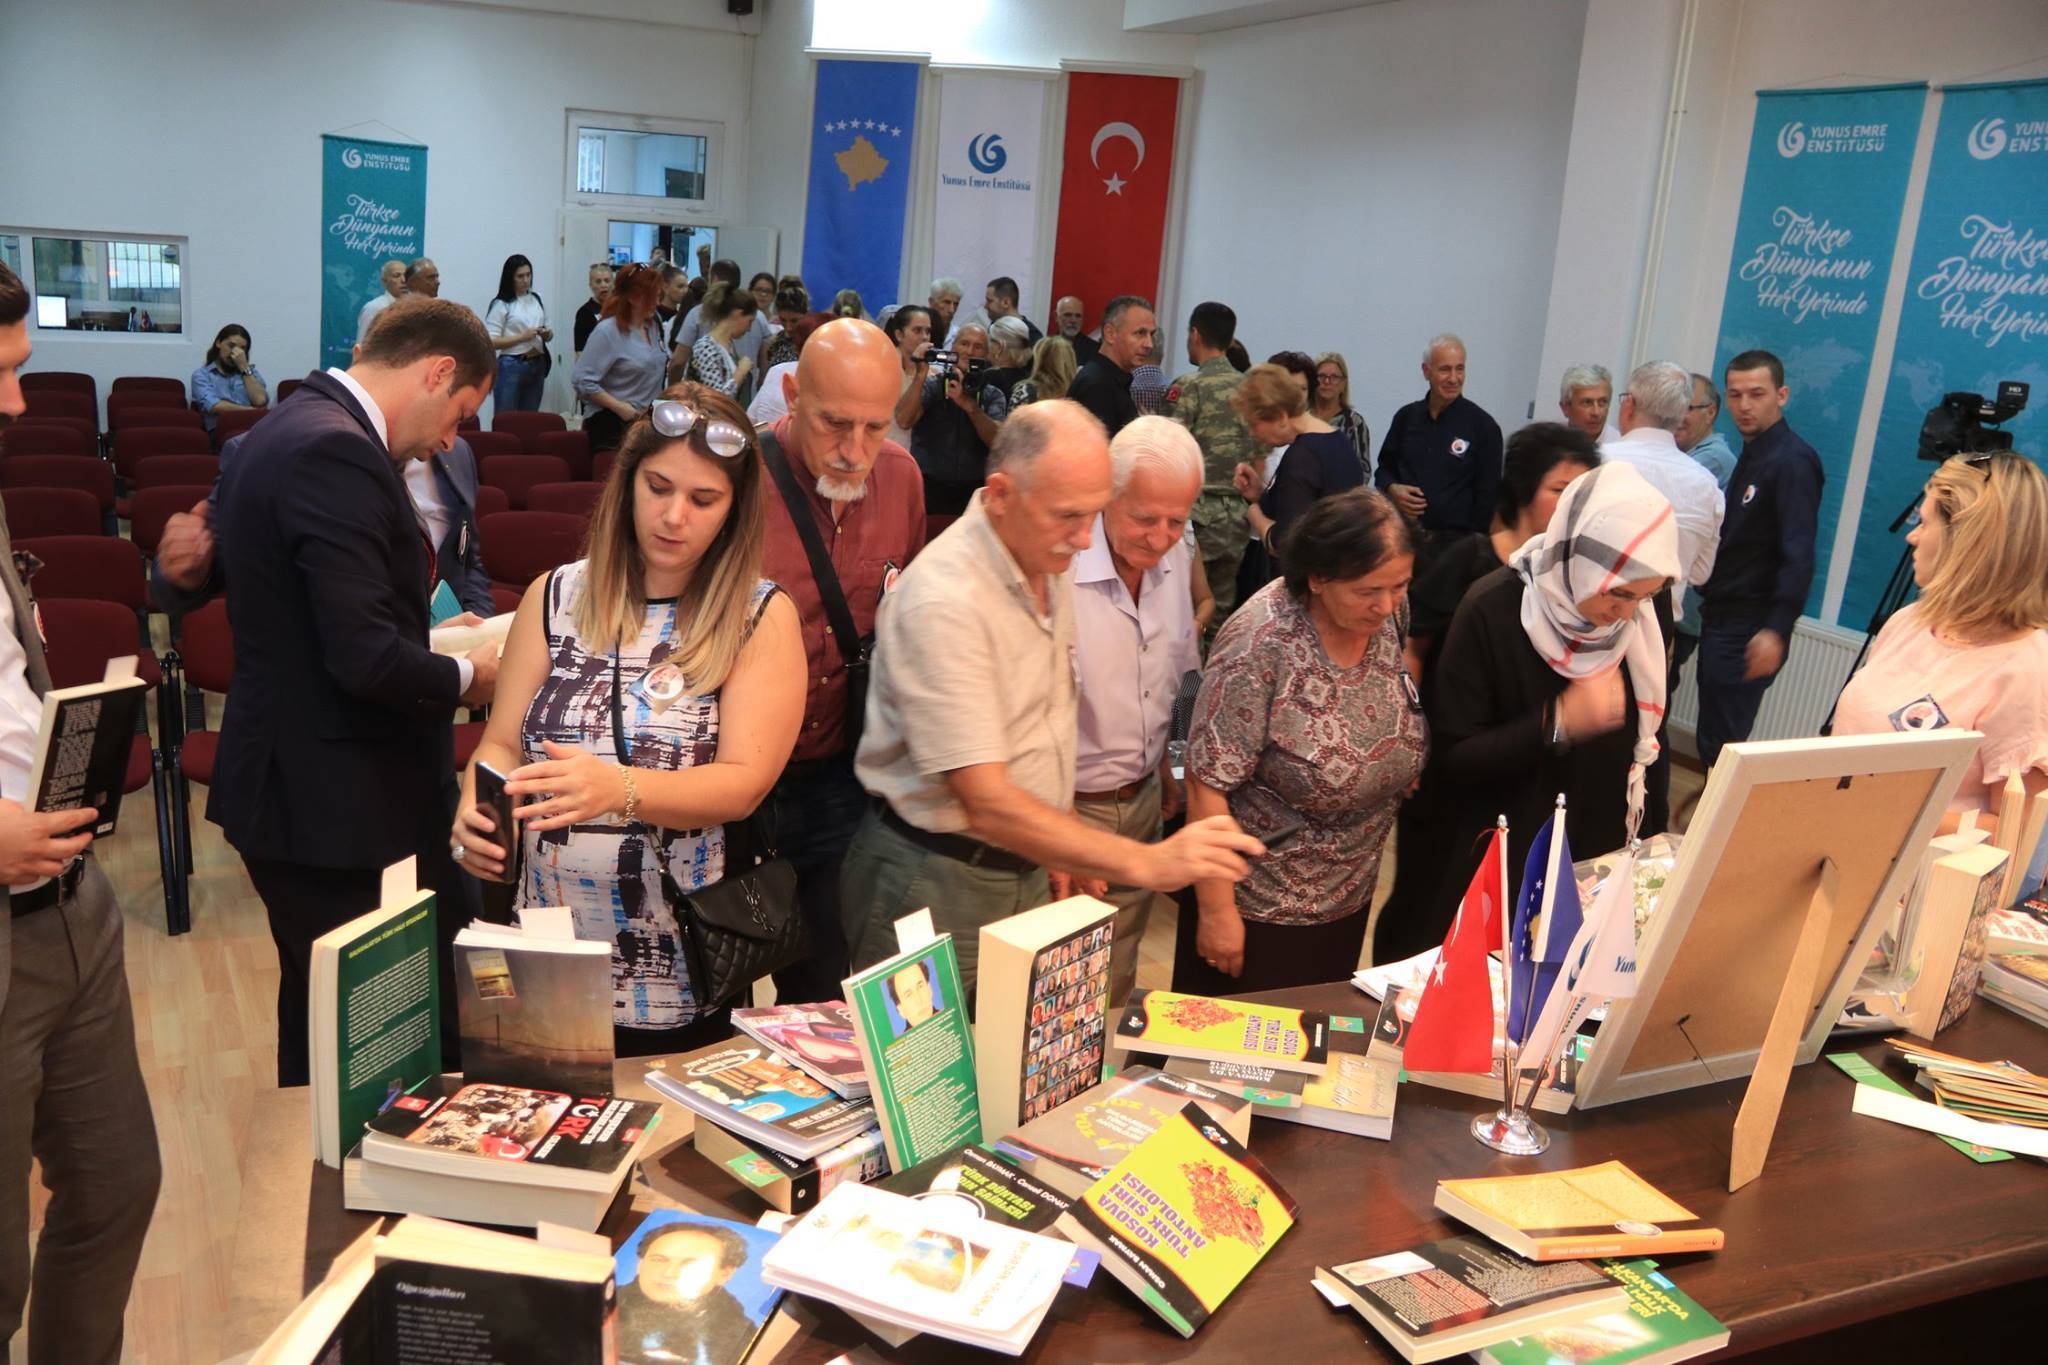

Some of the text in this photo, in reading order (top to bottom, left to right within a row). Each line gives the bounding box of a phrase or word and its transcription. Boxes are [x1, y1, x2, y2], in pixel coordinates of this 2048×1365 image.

[1811, 123, 1888, 138] YUNUS EMRE
[2016, 121, 2048, 136] YUN
[364, 153, 410, 164] YUNUS EMRE
[942, 173, 967, 187] Yunus
[969, 176, 990, 188] Emre
[347, 194, 400, 223] Türkçe
[344, 231, 416, 259] Her Yerinde
[1773, 206, 1853, 256] Türkçe
[1740, 242, 1874, 289] Dünyanın
[1757, 275, 1868, 324] Her Yerinde
[1939, 292, 1984, 338] Her
[1097, 1193, 1160, 1249] KOSOVA
[1148, 1215, 1190, 1259] TÜRK
[1108, 1235, 1165, 1289] OSMAN BAYMAK
